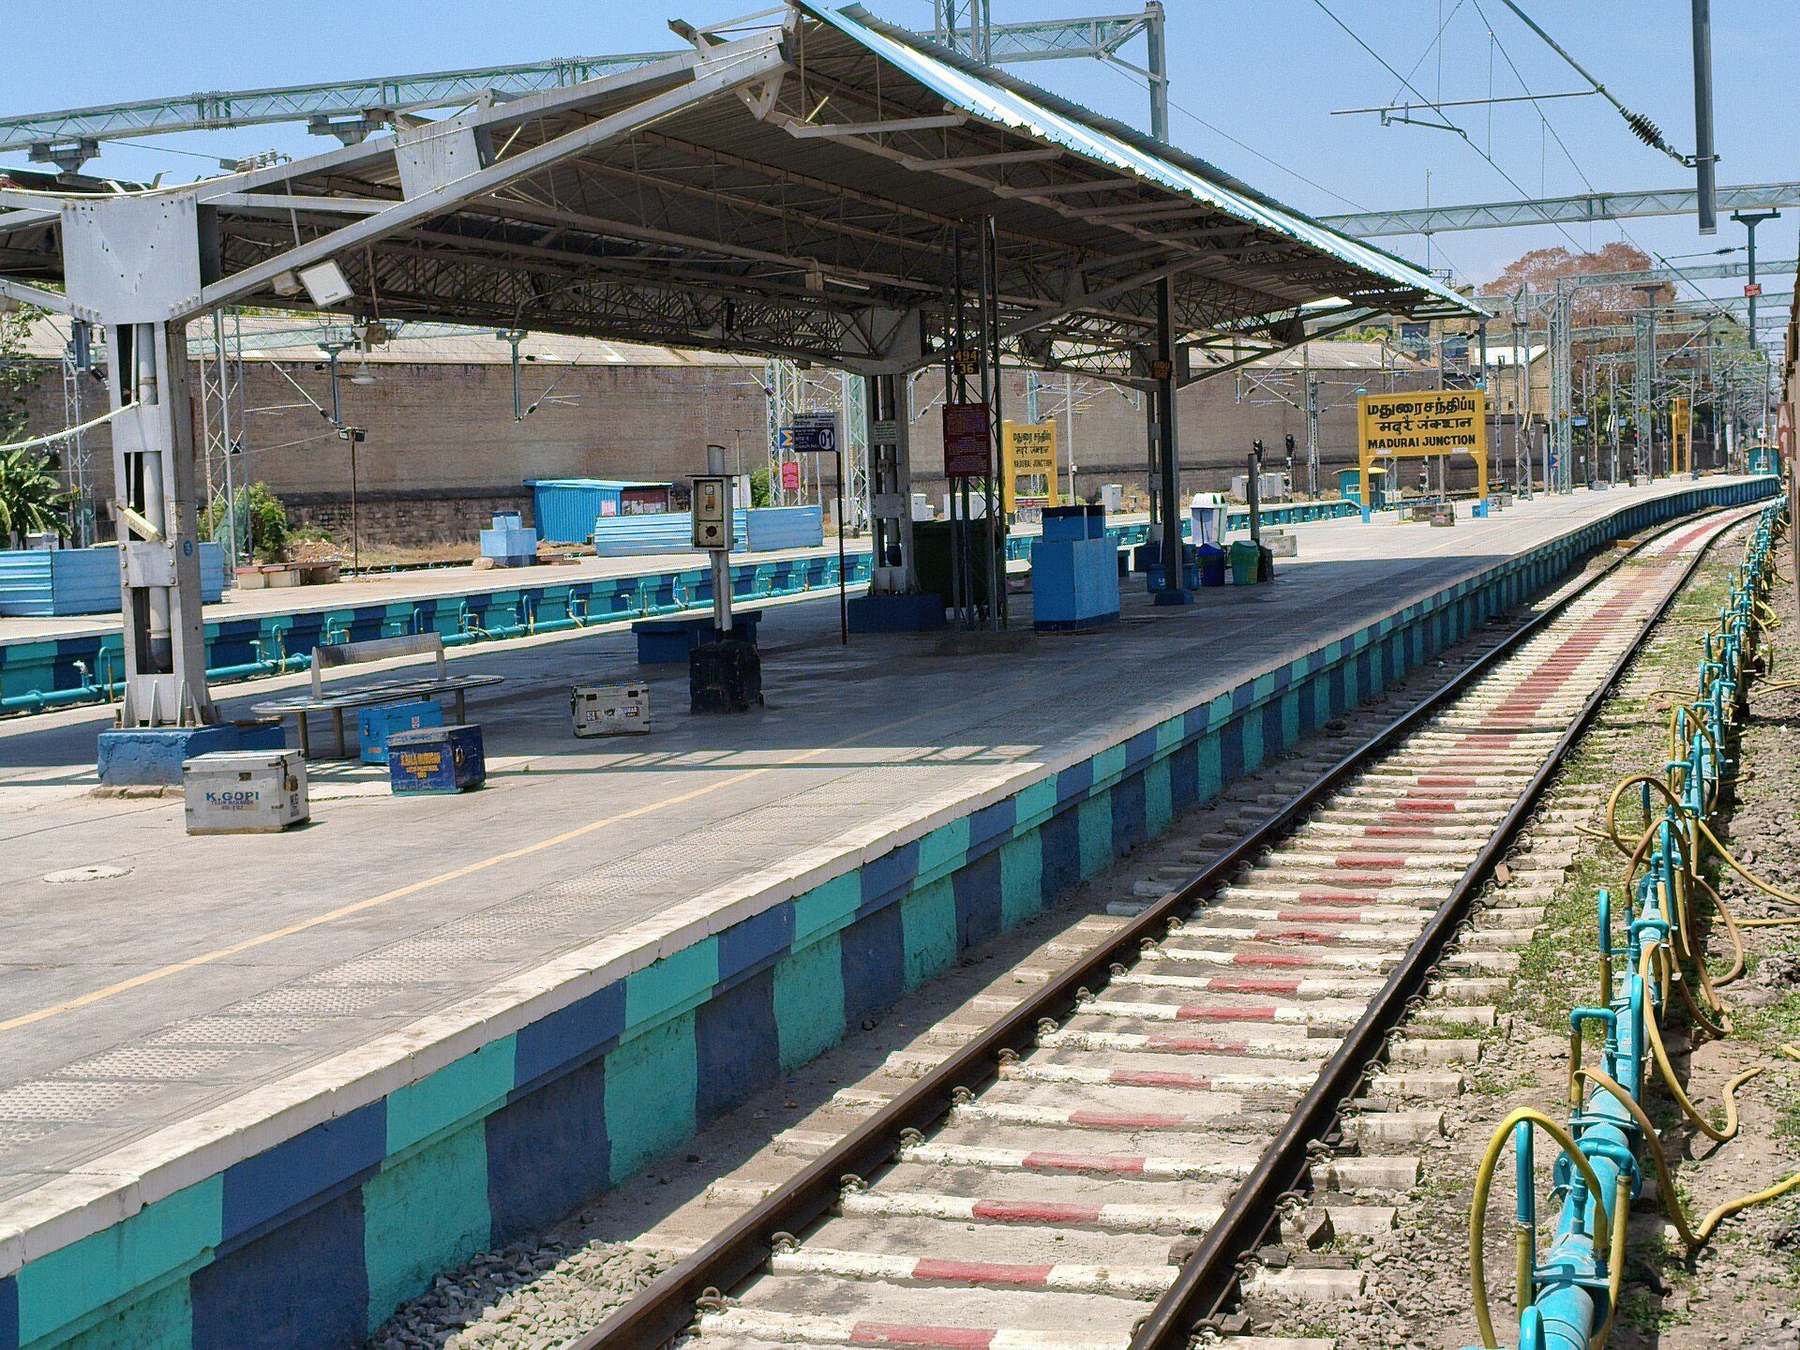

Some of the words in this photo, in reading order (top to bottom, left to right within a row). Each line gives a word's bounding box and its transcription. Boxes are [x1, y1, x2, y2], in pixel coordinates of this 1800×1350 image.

[955, 351, 977, 361] 494
[959, 363, 974, 374] 36
[820, 431, 832, 447] 01
[1367, 437, 1420, 449] MADURAI
[1422, 434, 1476, 447] JUNCTION
[205, 791, 260, 802] K.GOPI
